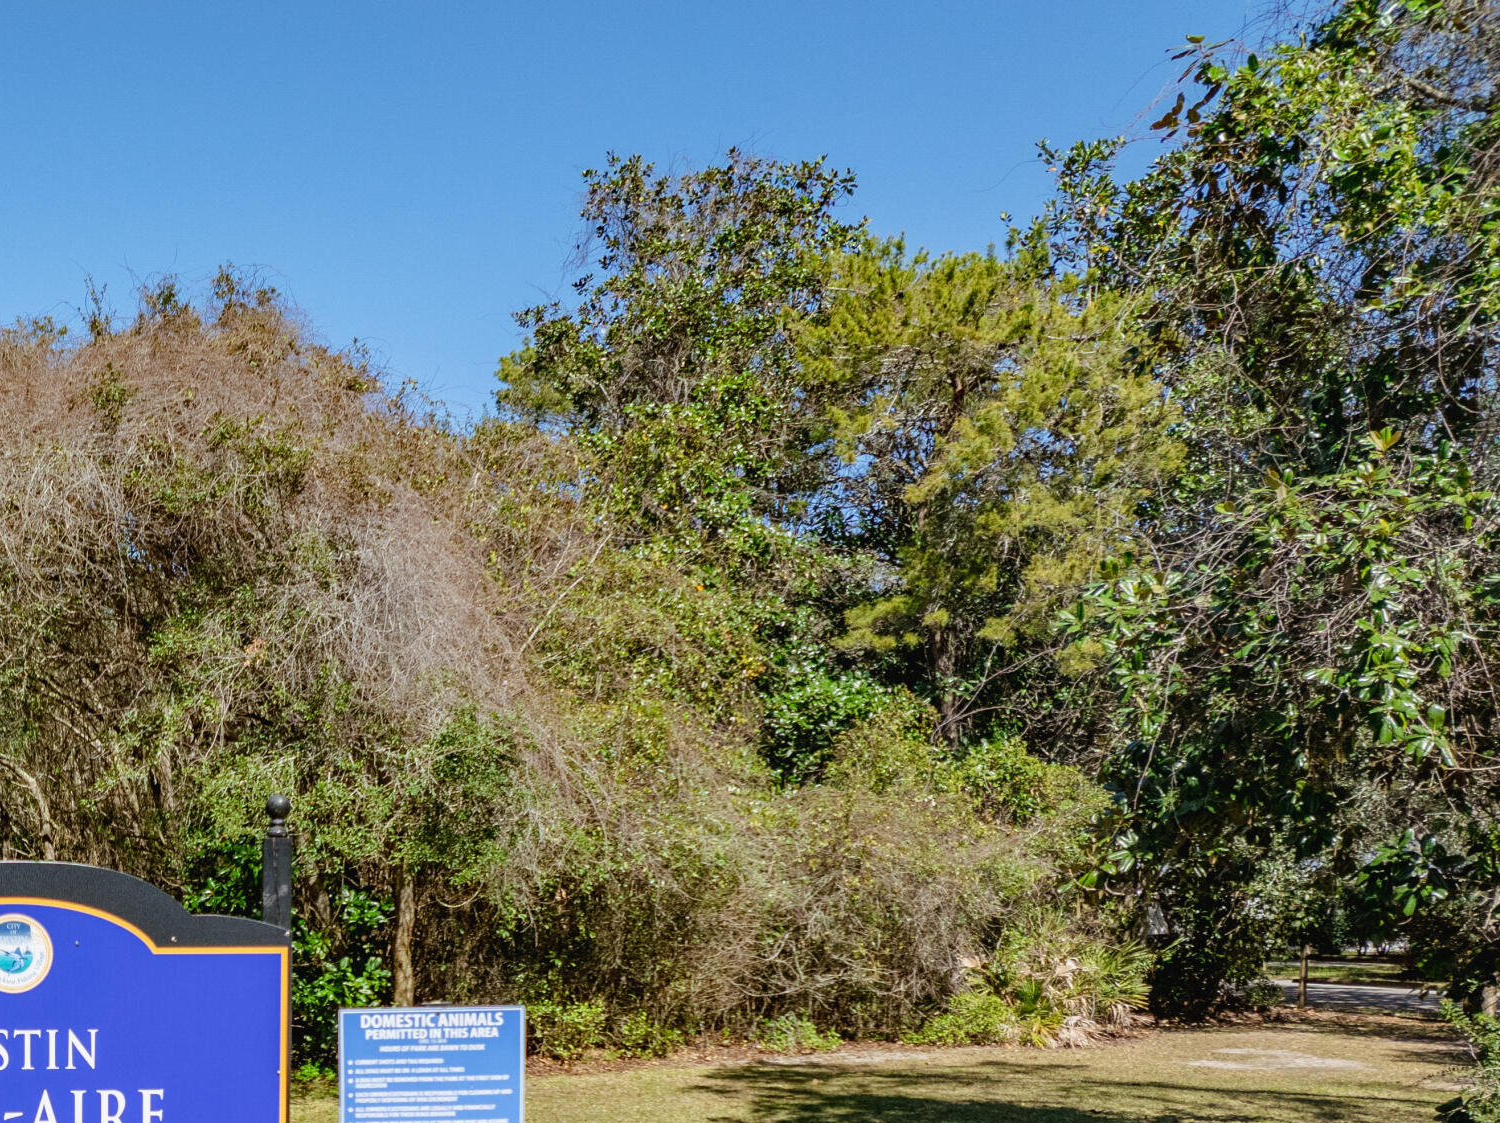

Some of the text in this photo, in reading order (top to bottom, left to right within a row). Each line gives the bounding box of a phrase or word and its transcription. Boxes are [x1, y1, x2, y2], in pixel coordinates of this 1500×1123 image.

[360, 1011, 505, 1030] DOMESTIC ANIMALS
[364, 1026, 499, 1041] PERMITTED IN THIS AREA
